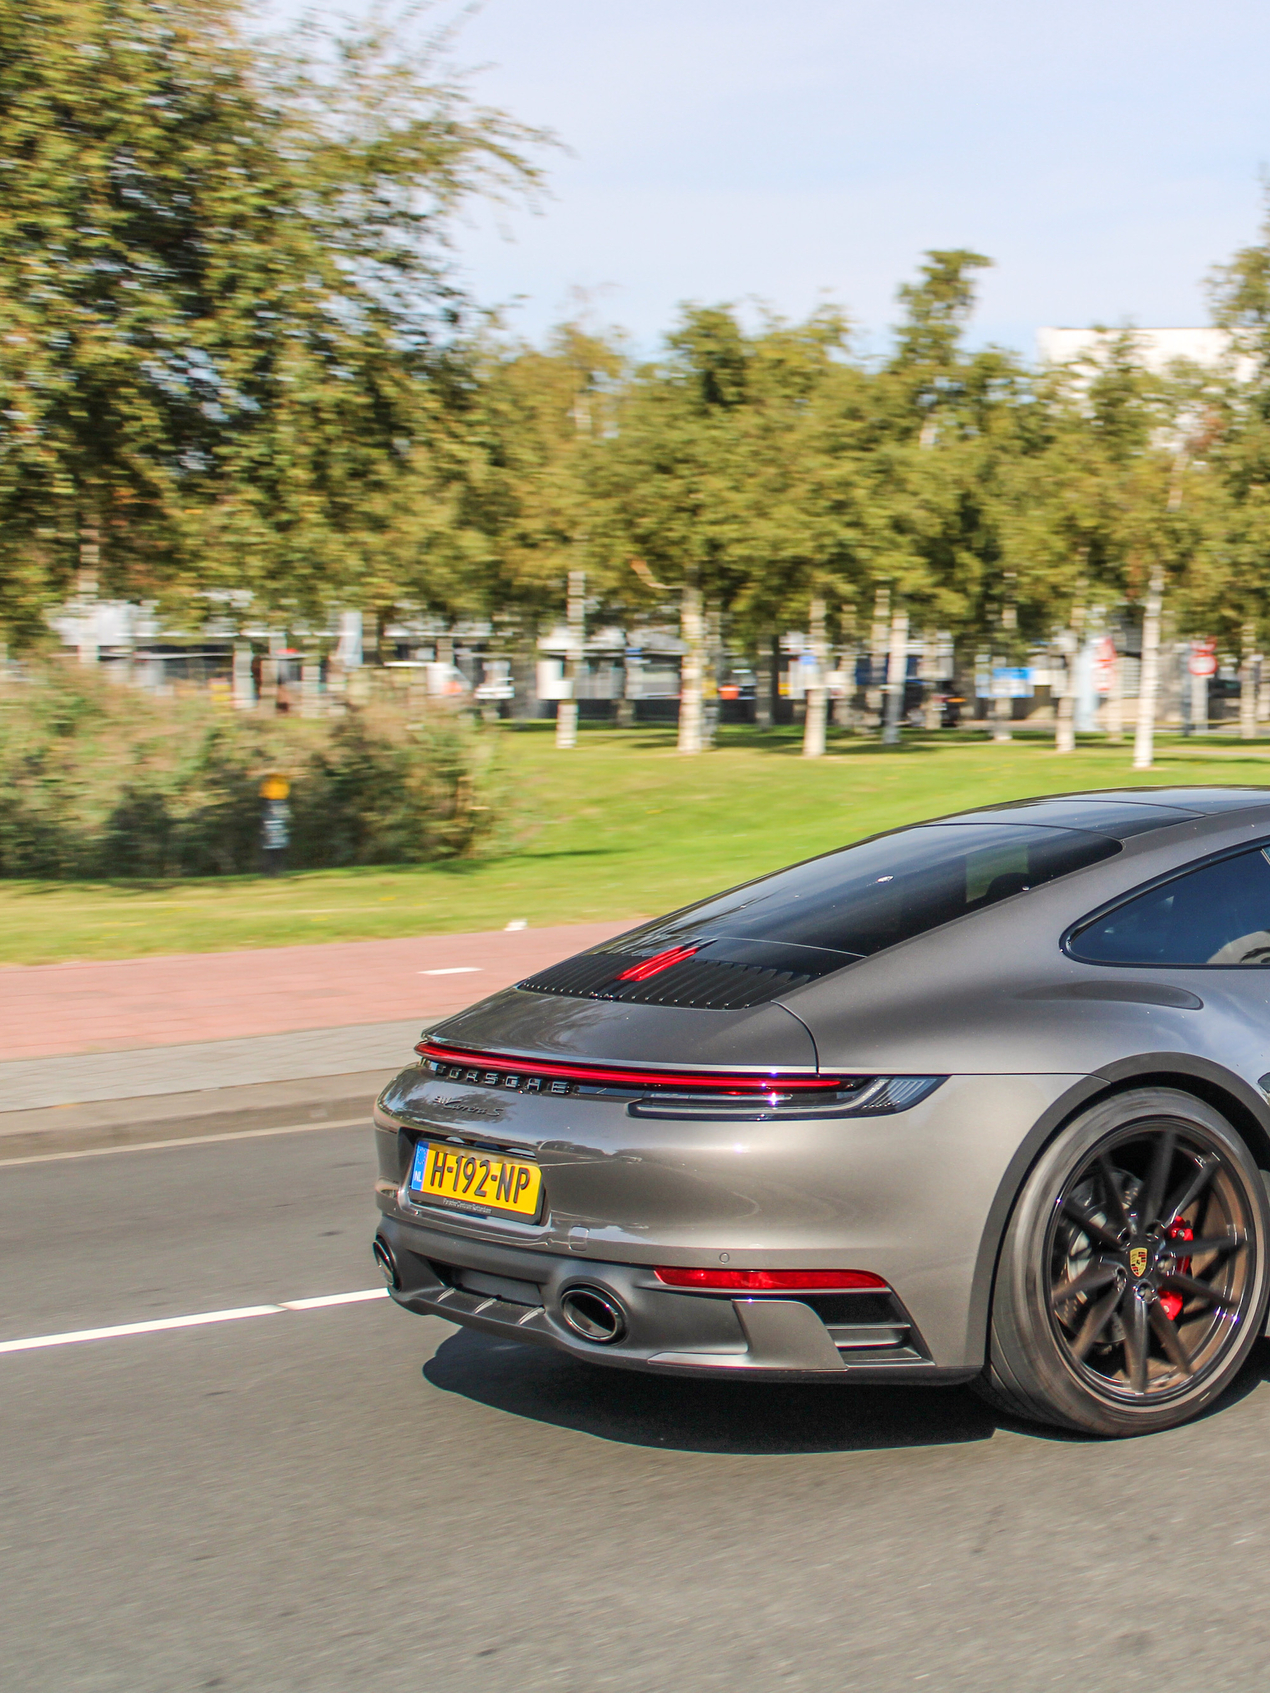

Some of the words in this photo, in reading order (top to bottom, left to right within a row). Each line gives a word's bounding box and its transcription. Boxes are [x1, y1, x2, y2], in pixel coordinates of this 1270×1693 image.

[434, 1063, 570, 1095] PORSCHE
[444, 1099, 488, 1115] Carrera
[488, 1108, 504, 1117] S
[413, 1170, 423, 1183] NL
[430, 1151, 531, 1204] H-192-NP
